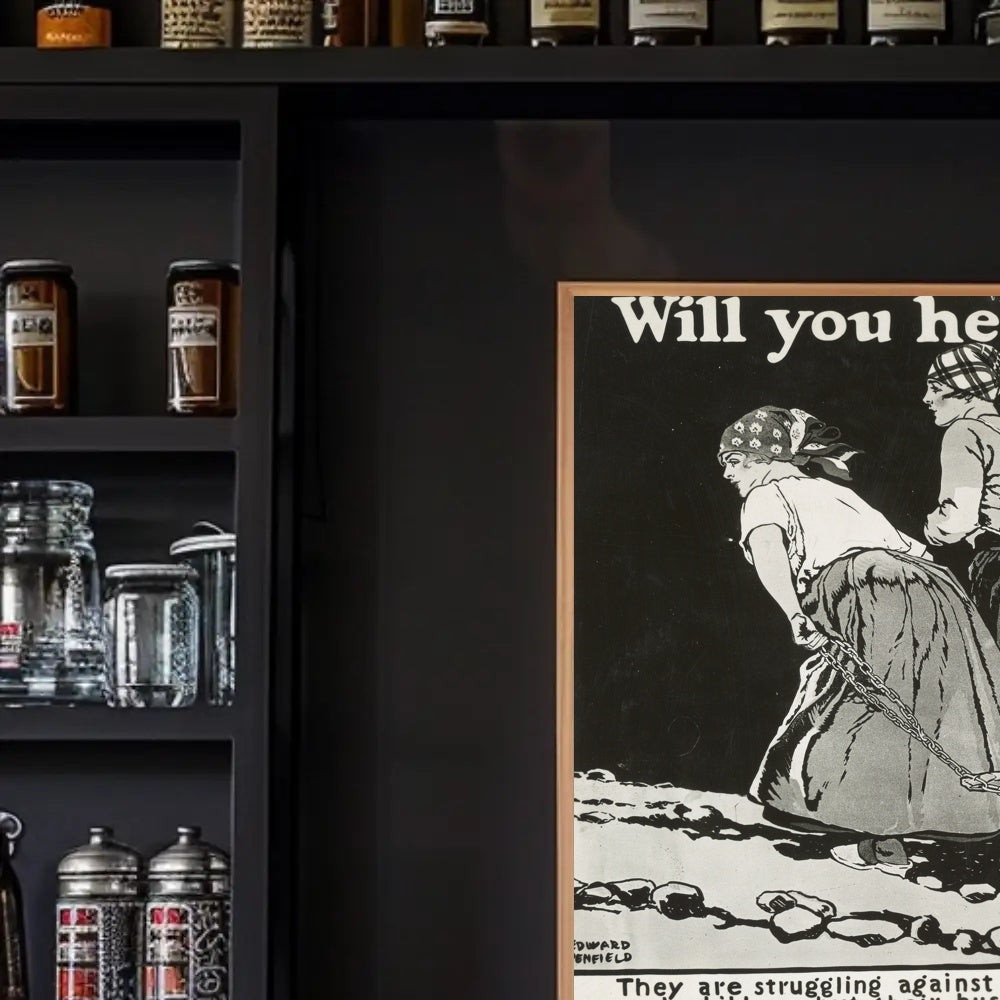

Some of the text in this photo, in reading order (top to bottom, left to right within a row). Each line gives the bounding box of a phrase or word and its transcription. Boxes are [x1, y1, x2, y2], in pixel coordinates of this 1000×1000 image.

[611, 296, 747, 344] Will
[765, 310, 892, 364] you
[574, 939, 631, 951] DWARD
[574, 952, 633, 965] ENFIELD
[616, 977, 684, 1000] They
[699, 981, 742, 997] are
[754, 976, 881, 998] struggling
[899, 973, 993, 998] against
